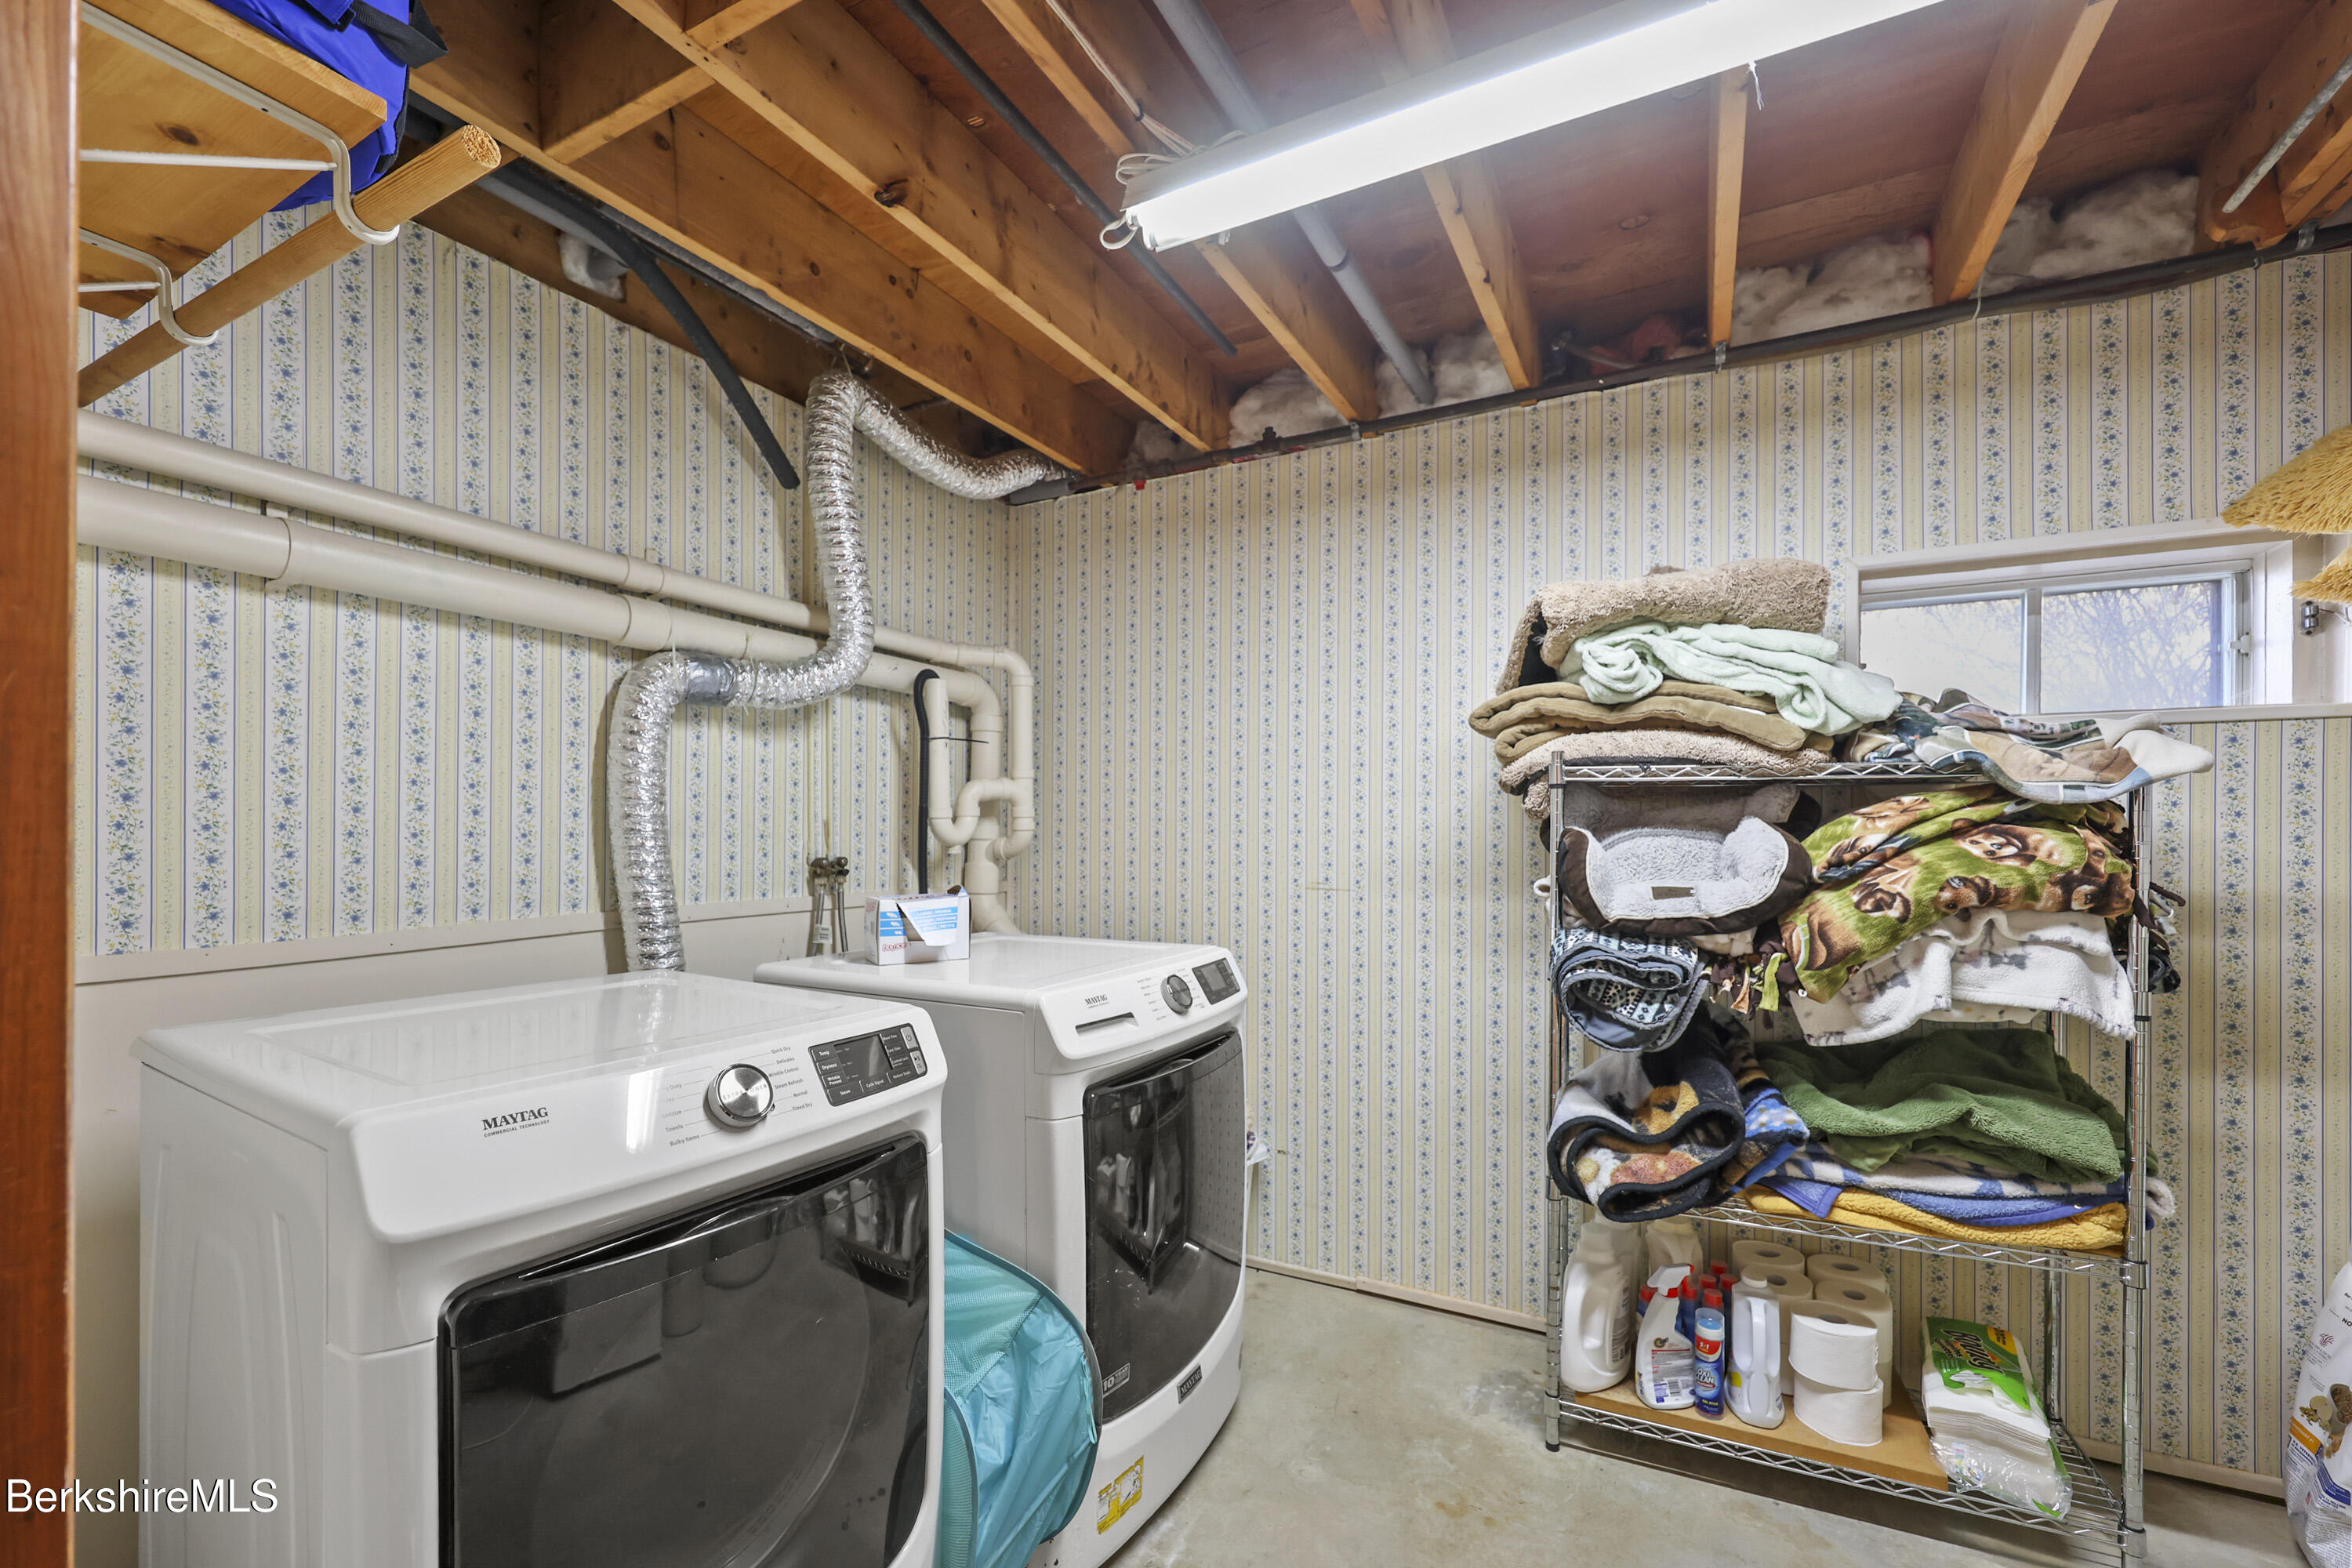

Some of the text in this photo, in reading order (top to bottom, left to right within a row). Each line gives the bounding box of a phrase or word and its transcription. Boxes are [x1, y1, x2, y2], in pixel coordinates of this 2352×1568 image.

[1084, 994, 1107, 1005] MAYTAG
[481, 1107, 549, 1131] MAYTAG
[484, 1120, 550, 1138] COMMERCIAL TECHNOLOGY
[666, 1124, 684, 1133] Towels
[1697, 1367, 1710, 1377] OXI
[1104, 1376, 1115, 1392] 10
[1181, 1370, 1202, 1396] MAYTAG
